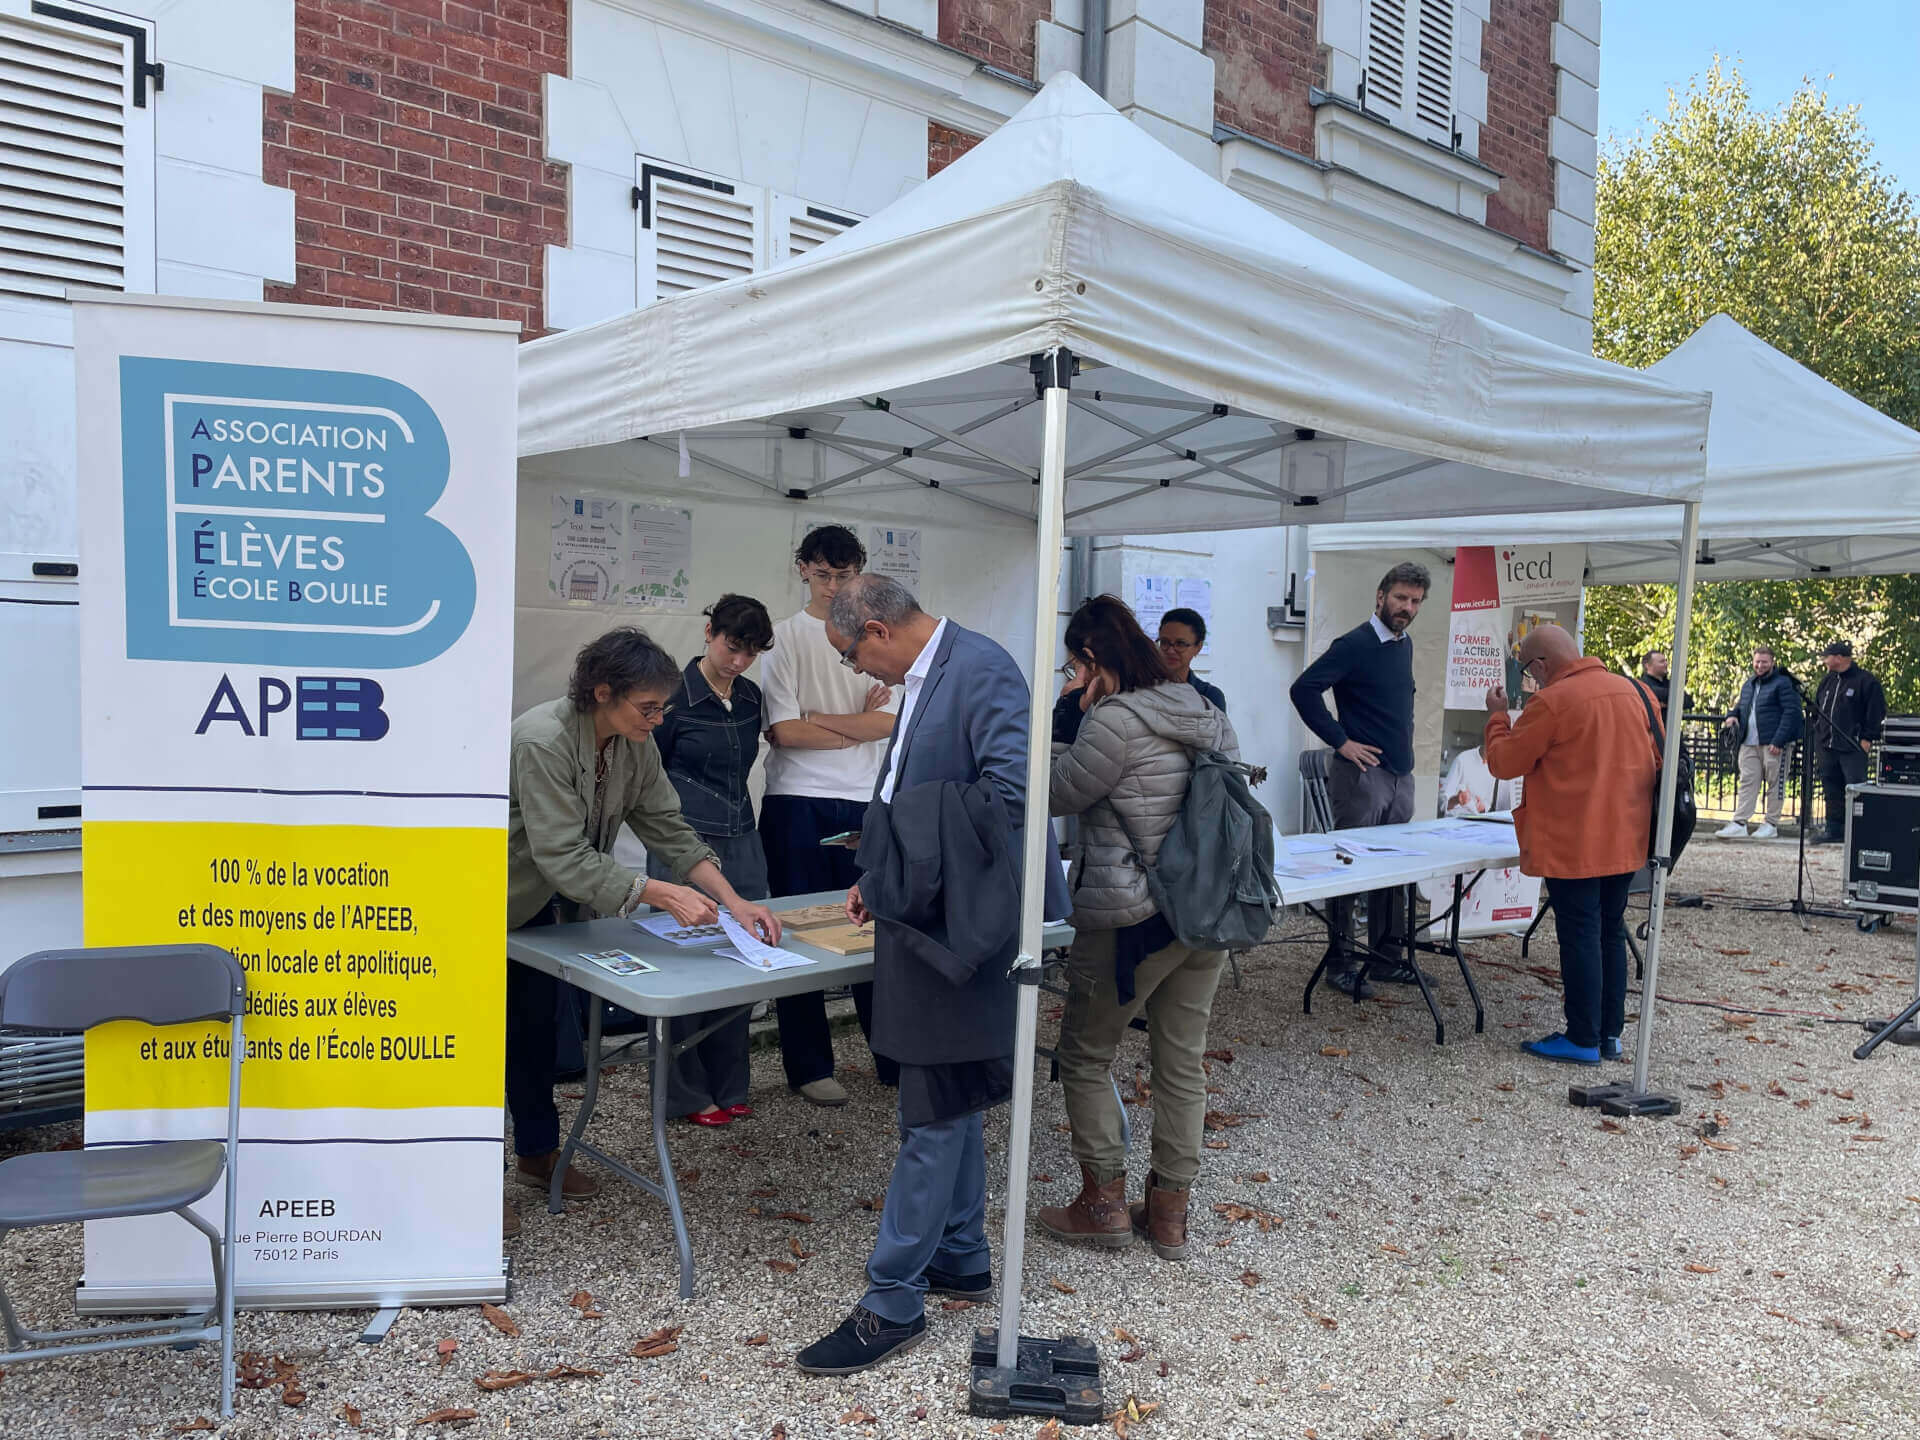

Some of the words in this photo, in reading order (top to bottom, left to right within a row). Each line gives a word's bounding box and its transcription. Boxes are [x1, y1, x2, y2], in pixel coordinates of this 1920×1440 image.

[191, 418, 387, 451] ASSOCIATION
[192, 454, 385, 498] PARENTS
[194, 520, 345, 571] ÉLÈVES
[1504, 552, 1552, 582] iecd
[194, 570, 279, 601] ÉCOLE
[289, 581, 388, 606] BOULLE
[1455, 634, 1490, 645] FORMER
[1464, 646, 1500, 657] ACTEURS
[1453, 657, 1501, 667] RESPONSABLES
[1468, 678, 1477, 688] 16
[210, 858, 240, 884] 100
[246, 858, 261, 885] %
[266, 860, 287, 886] de
[293, 861, 308, 887] la
[314, 861, 389, 888] vocation
[178, 903, 196, 928] et
[202, 902, 234, 928] des
[240, 909, 307, 935] moyens
[313, 905, 335, 930] de
[266, 948, 319, 974] locale
[324, 949, 342, 973] et
[346, 949, 437, 981] apolitique,
[245, 989, 299, 1018] dédiés
[304, 998, 338, 1017] aux
[343, 991, 397, 1018] élèves
[140, 1036, 158, 1061] et
[163, 1040, 197, 1060] aux
[203, 1033, 283, 1061] étuants
[288, 1036, 310, 1061] de
[380, 1034, 456, 1061] BOULLE
[258, 1199, 336, 1218] APEEB
[255, 1231, 298, 1244] Pierre
[303, 1229, 382, 1243] BOURDAN
[253, 1249, 298, 1262] 75012
[302, 1248, 339, 1261] Paris
